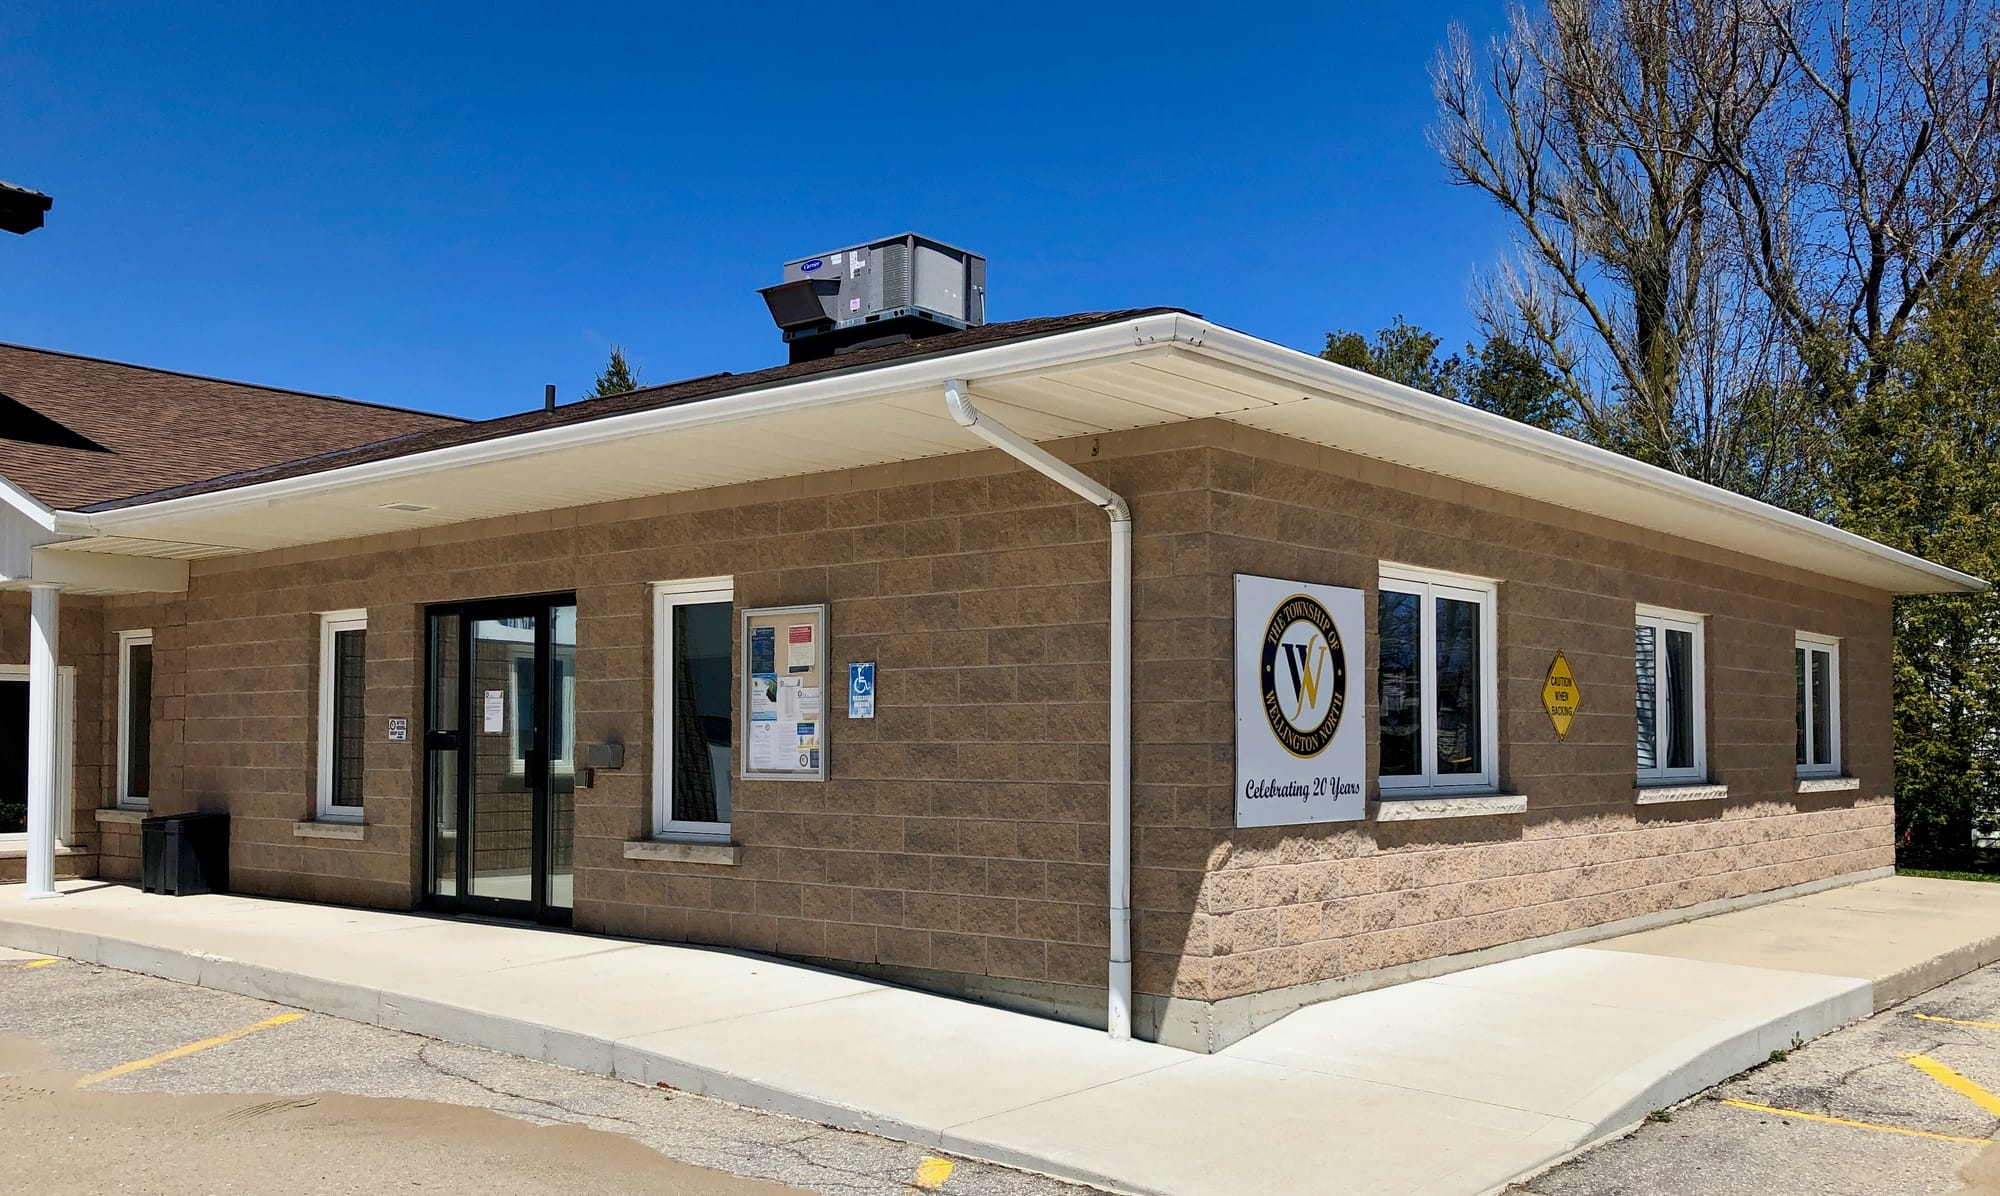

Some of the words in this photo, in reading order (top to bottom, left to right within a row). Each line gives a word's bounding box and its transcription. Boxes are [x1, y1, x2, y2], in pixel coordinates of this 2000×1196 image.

[1267, 613, 1286, 646] THE
[1283, 601, 1331, 632] TOWNSHIP
[1327, 631, 1340, 650] OF
[1551, 676, 1572, 687] CAUTION
[1554, 691, 1569, 701] WHEN
[1265, 689, 1319, 752] WELLINGTON
[1319, 691, 1343, 744] NORTH
[1551, 706, 1573, 716] BACKING
[1245, 778, 1310, 803] Celebrating
[1313, 777, 1328, 797] 20
[1330, 776, 1360, 802] Years
